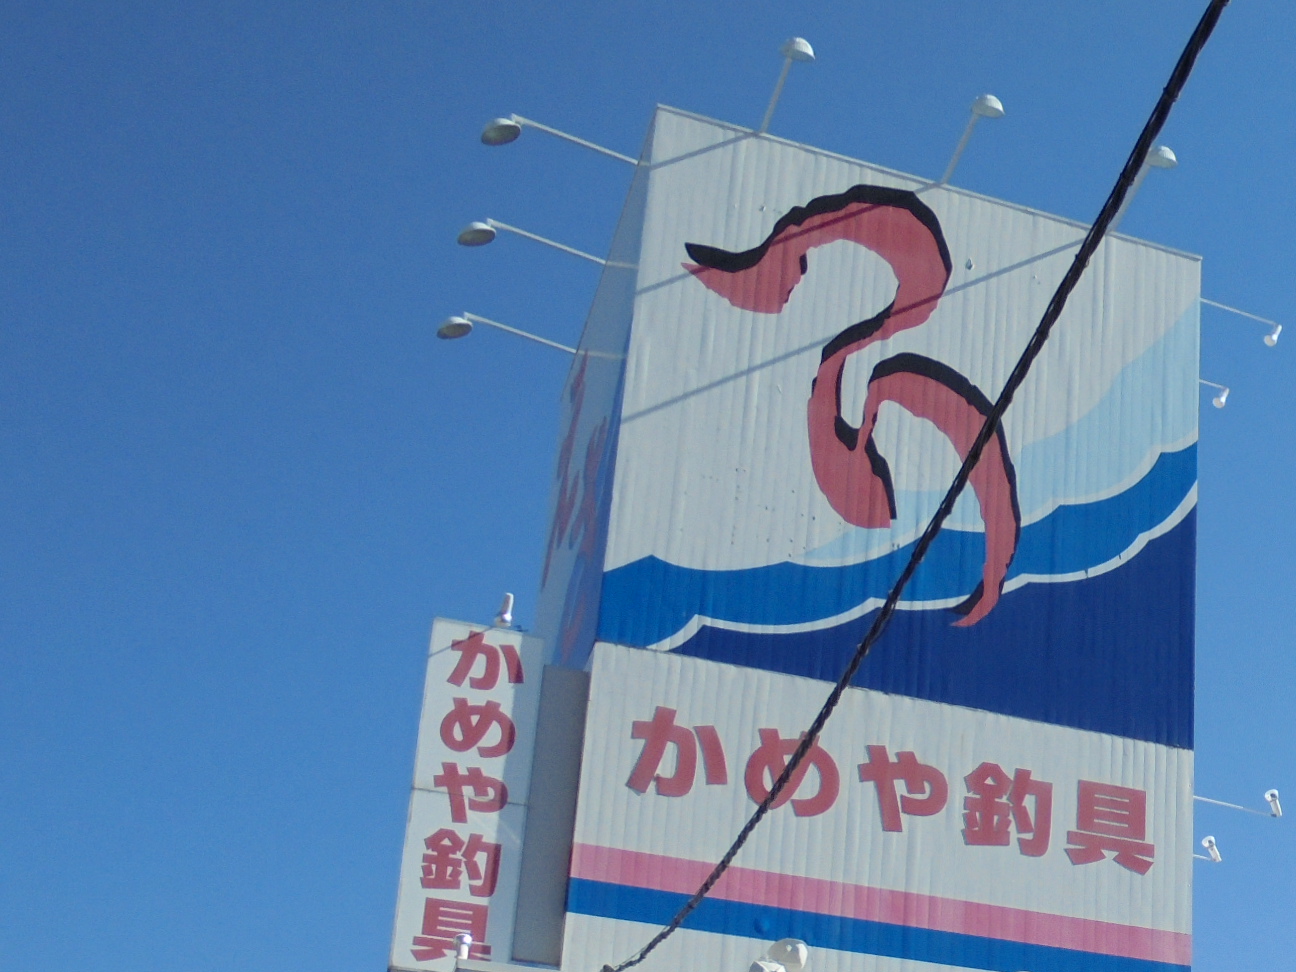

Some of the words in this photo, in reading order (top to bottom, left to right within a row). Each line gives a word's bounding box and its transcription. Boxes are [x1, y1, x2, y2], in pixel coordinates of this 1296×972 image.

[412, 629, 523, 962] かめや釣具
[624, 706, 1155, 875] かめや釣具
